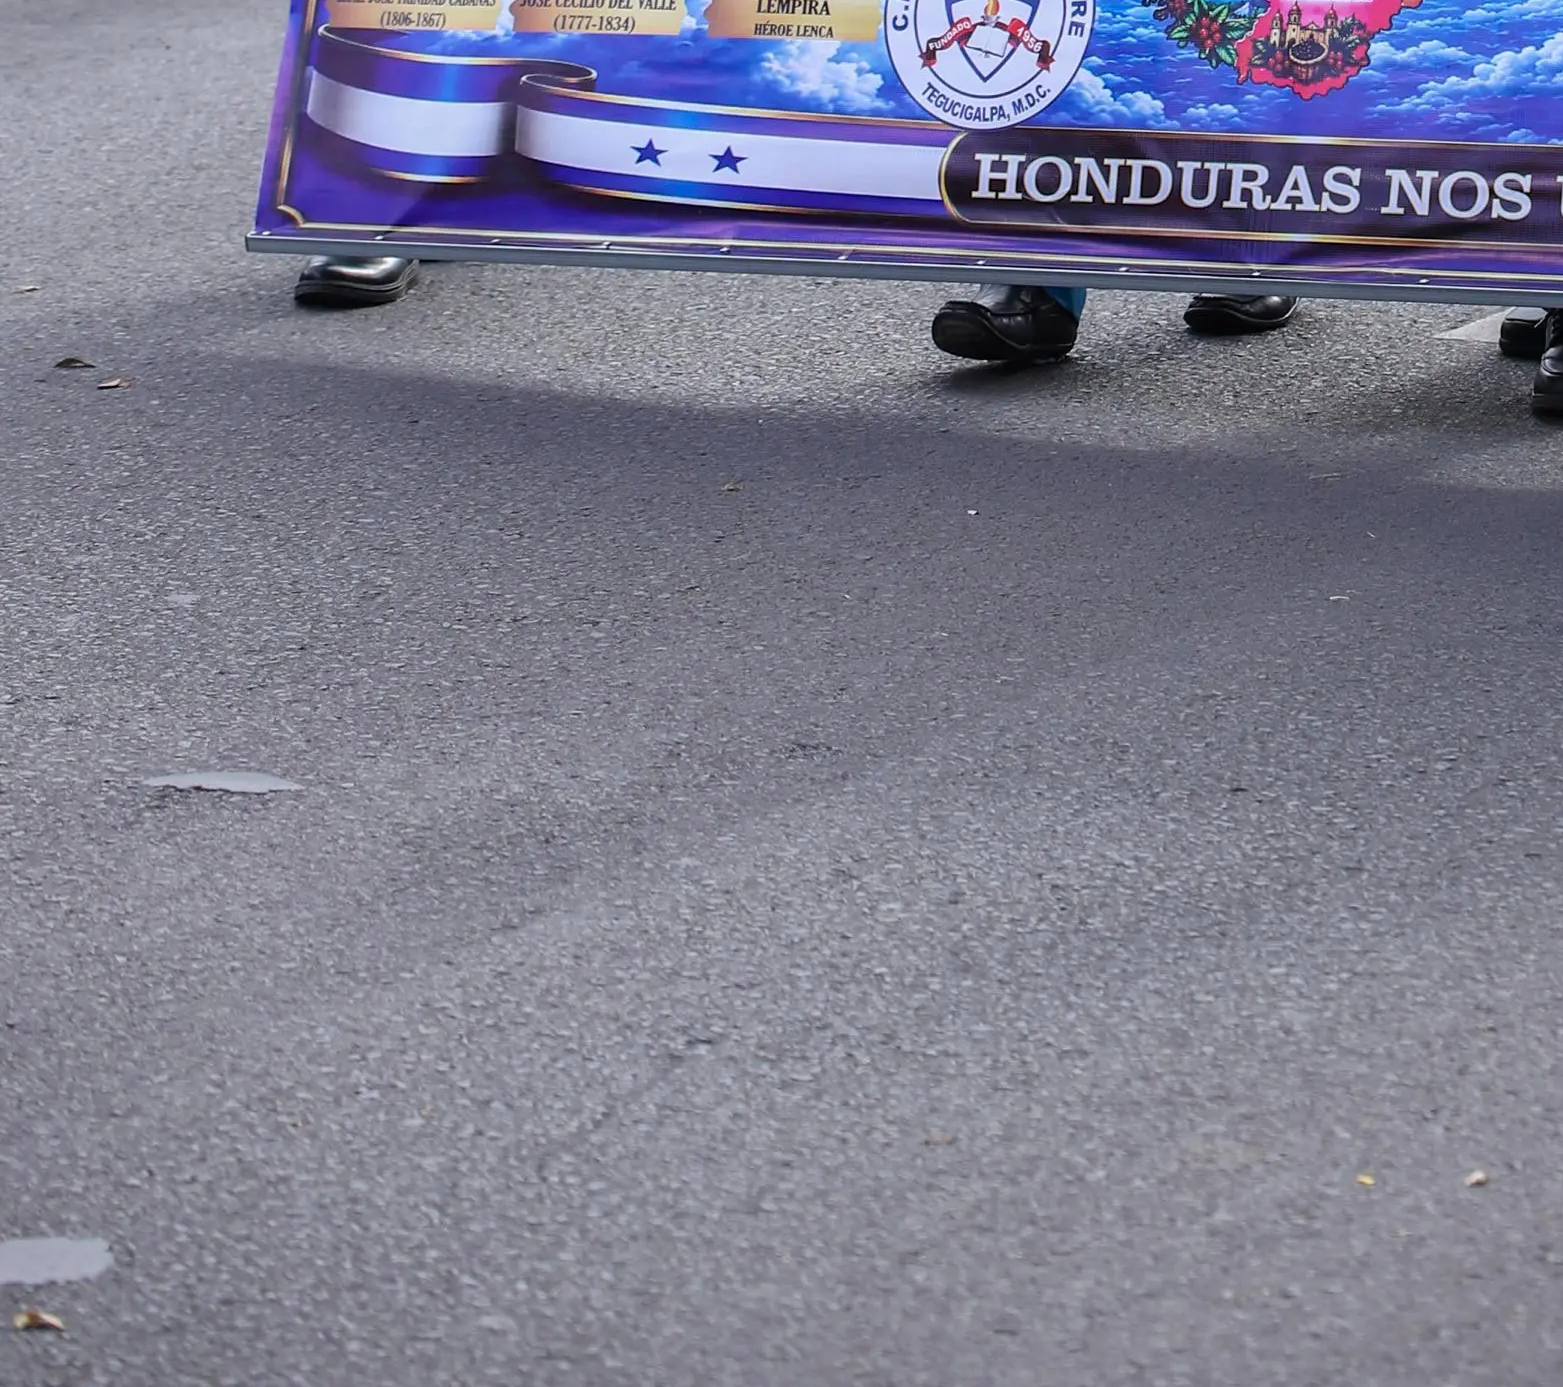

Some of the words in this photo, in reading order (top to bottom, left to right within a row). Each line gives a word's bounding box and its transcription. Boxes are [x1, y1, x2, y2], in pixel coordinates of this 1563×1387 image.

[380, 11, 446, 29] (1806-1867)
[553, 14, 636, 33] (1777-1834)
[753, 21, 793, 36] HÉROE
[795, 25, 834, 38] LENCA
[928, 20, 972, 52] FUNDADO
[1016, 26, 1044, 53] 1956
[921, 82, 1011, 123] TEGUCIGALPA,
[1012, 83, 1052, 117] M.D.C.
[970, 152, 1363, 213] HONDURAS
[1381, 168, 1533, 221] NOS
